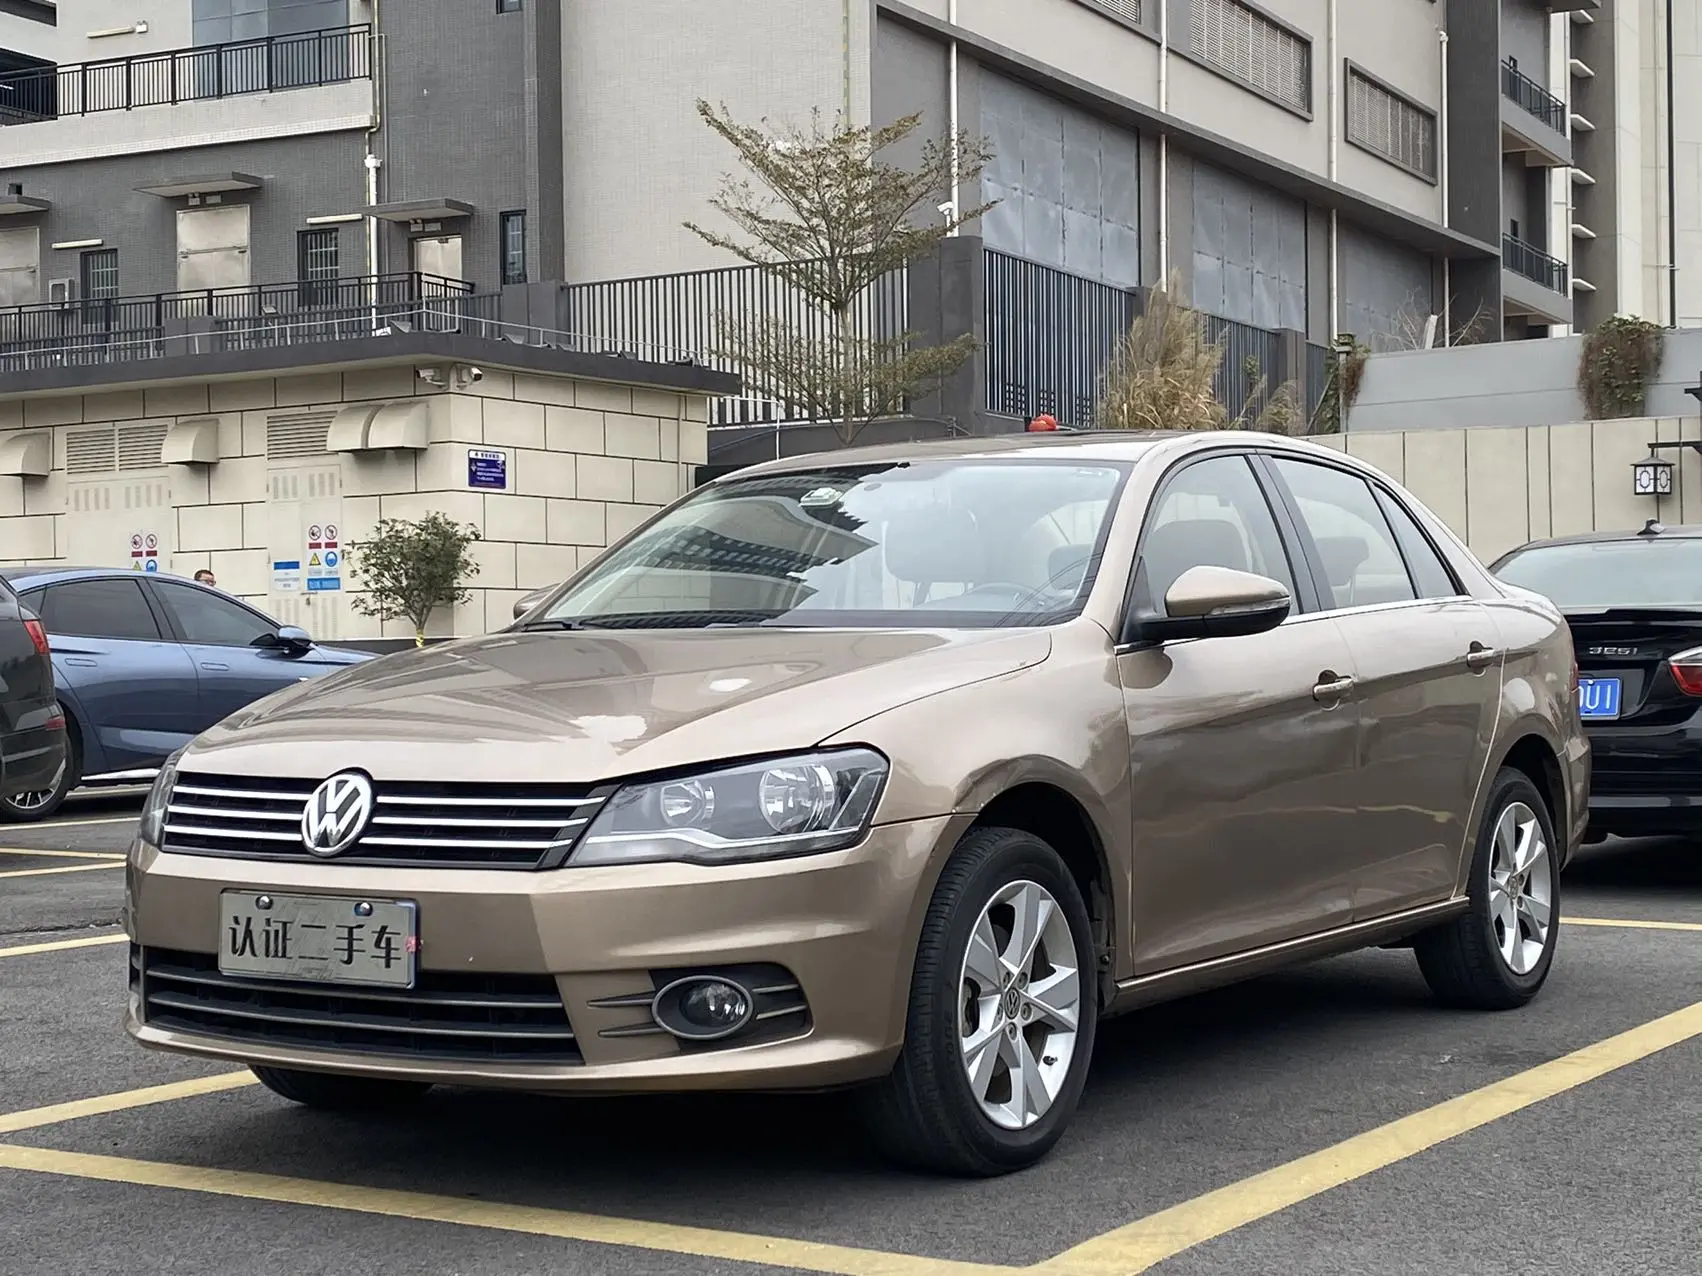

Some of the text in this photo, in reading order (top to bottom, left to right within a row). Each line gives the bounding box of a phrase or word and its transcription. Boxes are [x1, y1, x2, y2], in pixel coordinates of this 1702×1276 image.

[303, 775, 371, 851] VW
[228, 915, 402, 969] 认证二手车
